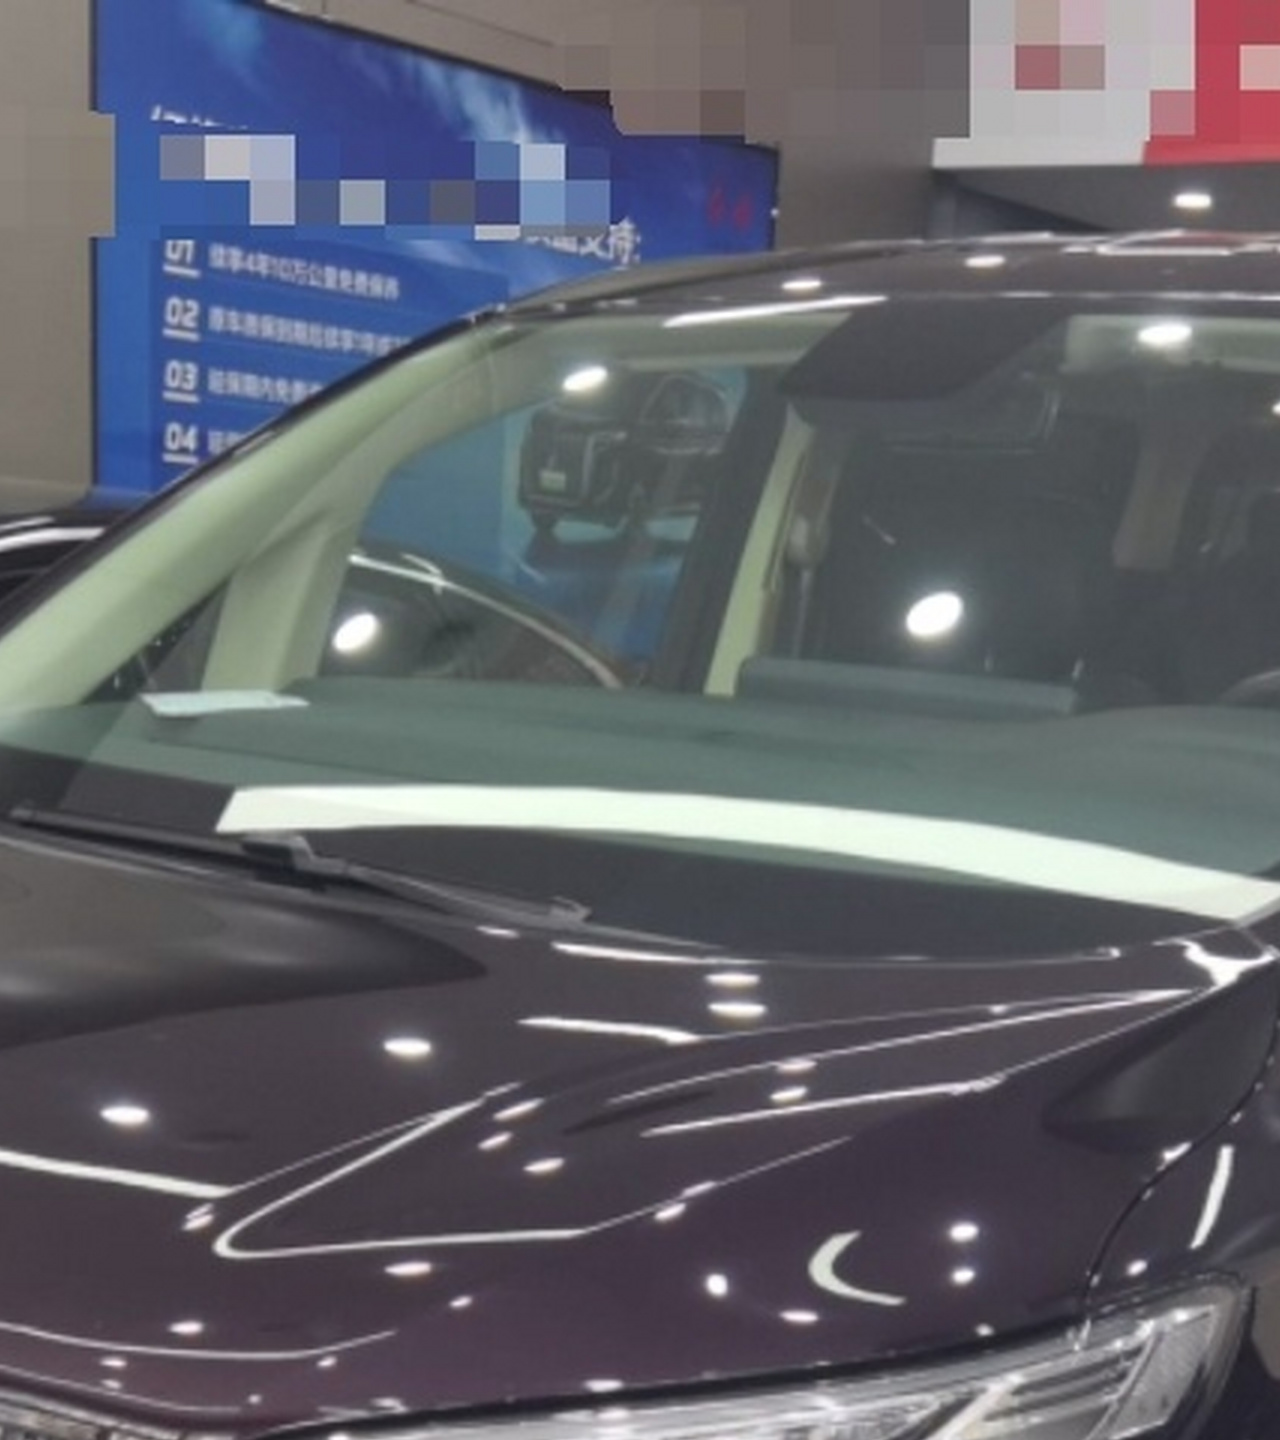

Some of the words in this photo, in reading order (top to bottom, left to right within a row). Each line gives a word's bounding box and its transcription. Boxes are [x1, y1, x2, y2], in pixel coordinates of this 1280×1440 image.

[164, 297, 200, 329] 02
[164, 360, 198, 391] 03
[164, 422, 198, 452] 04
